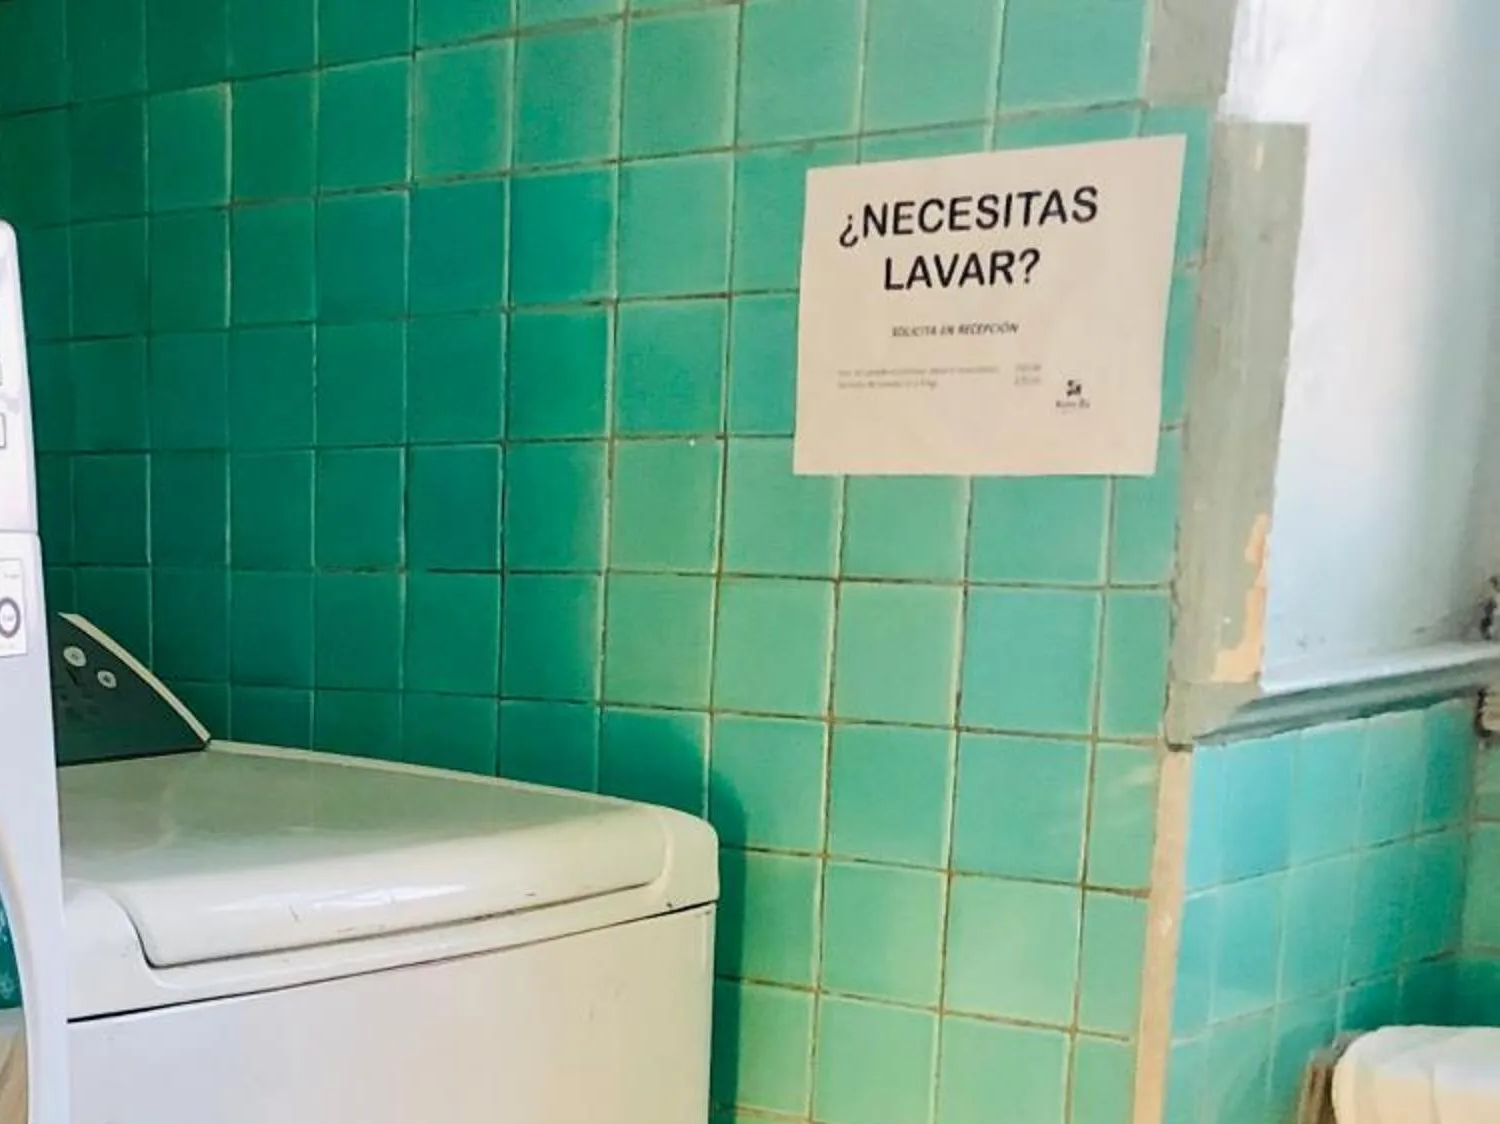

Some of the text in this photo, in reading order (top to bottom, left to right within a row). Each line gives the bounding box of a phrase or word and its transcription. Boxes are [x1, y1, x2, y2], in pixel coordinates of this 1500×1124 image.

[838, 185, 1099, 249] ¿NECESITAS
[883, 248, 1042, 291] LAVAR?
[957, 319, 1020, 335] RECEPCIÓN
